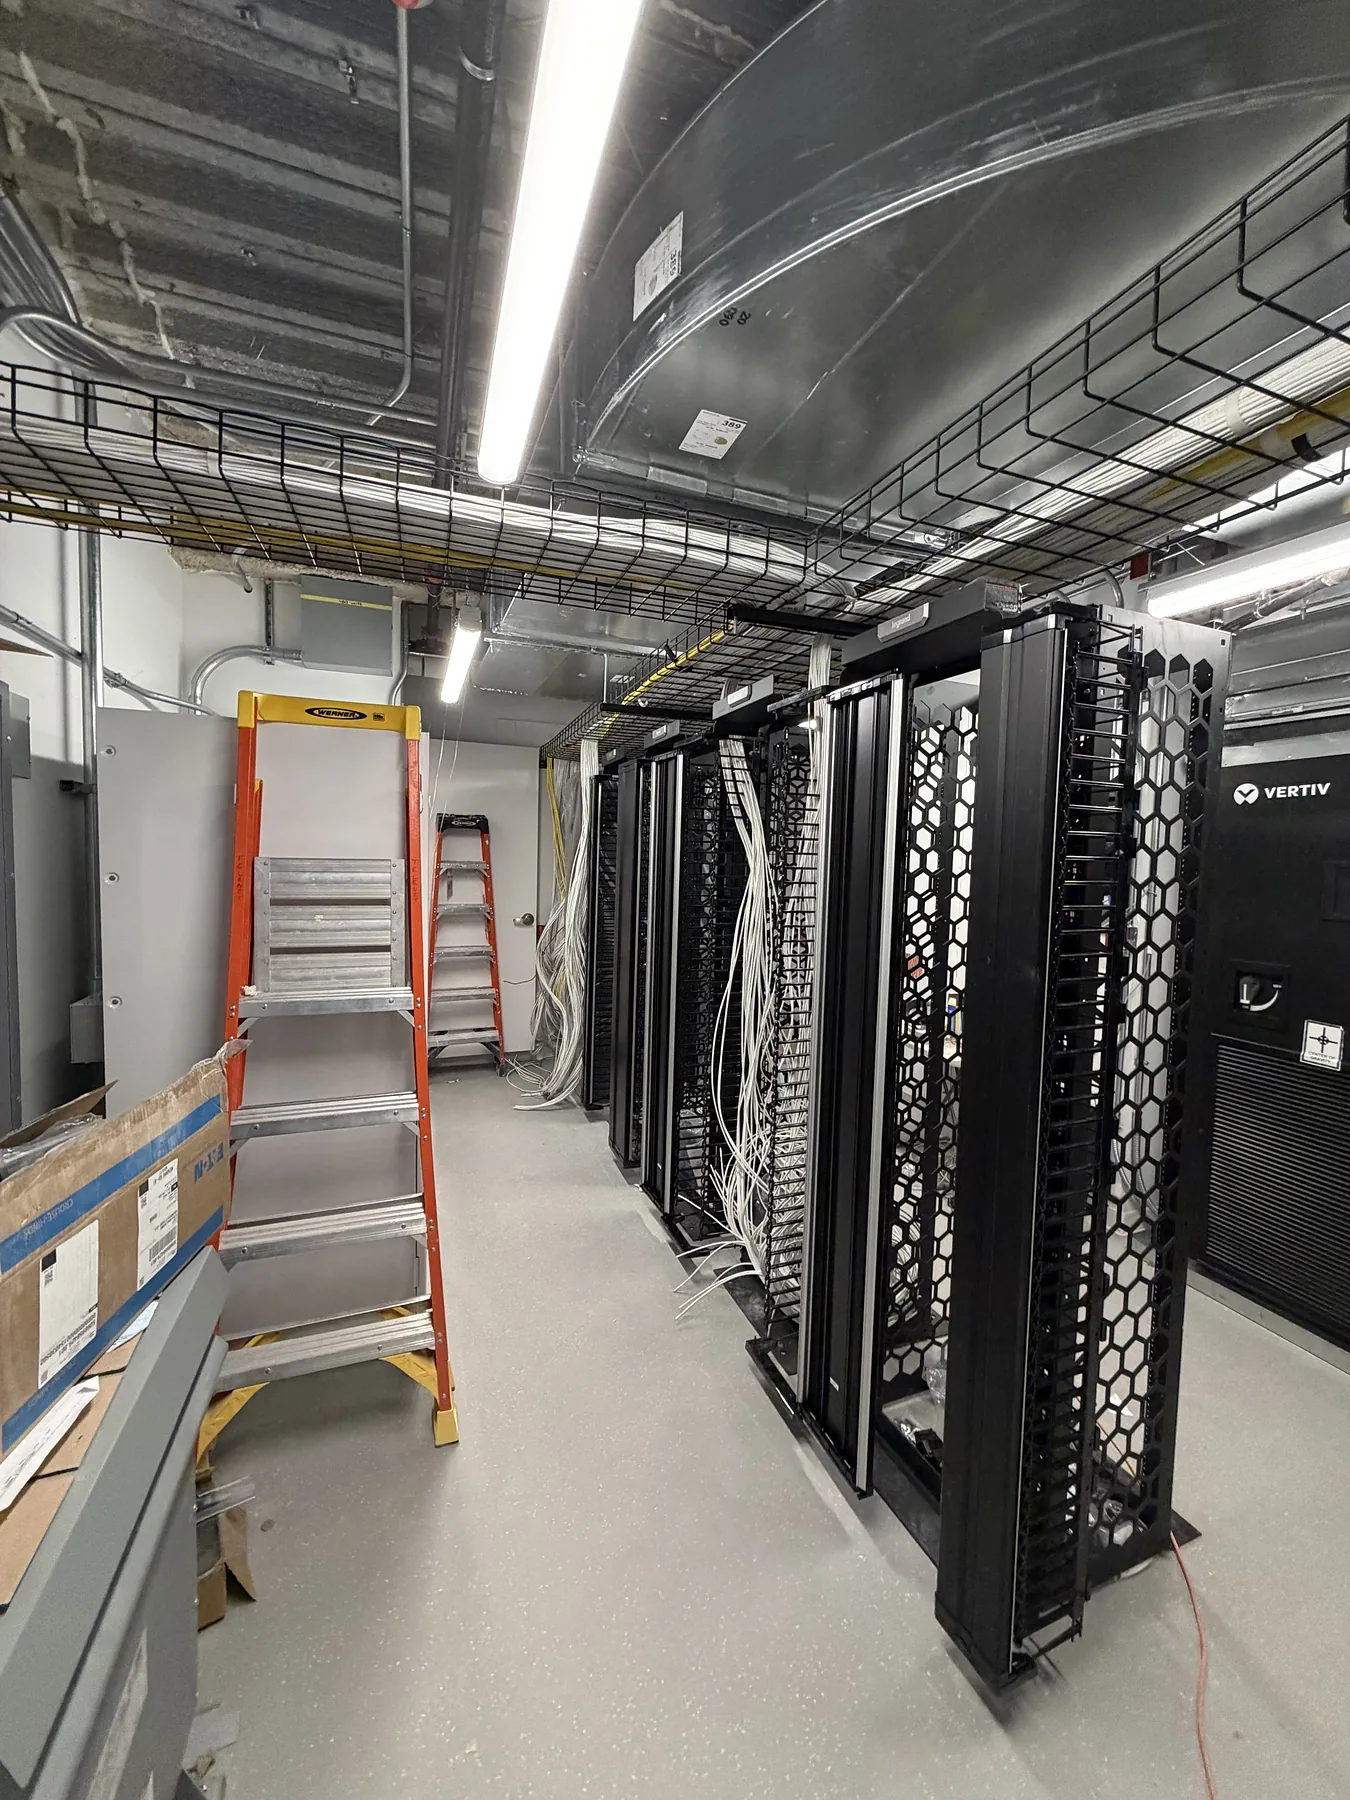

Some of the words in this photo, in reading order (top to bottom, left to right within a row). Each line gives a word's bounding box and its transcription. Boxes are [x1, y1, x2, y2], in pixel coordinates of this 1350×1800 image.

[721, 420, 742, 430] 389
[891, 613, 911, 629] legrand
[318, 709, 355, 718] WERNER
[1264, 782, 1331, 799] VERTIV
